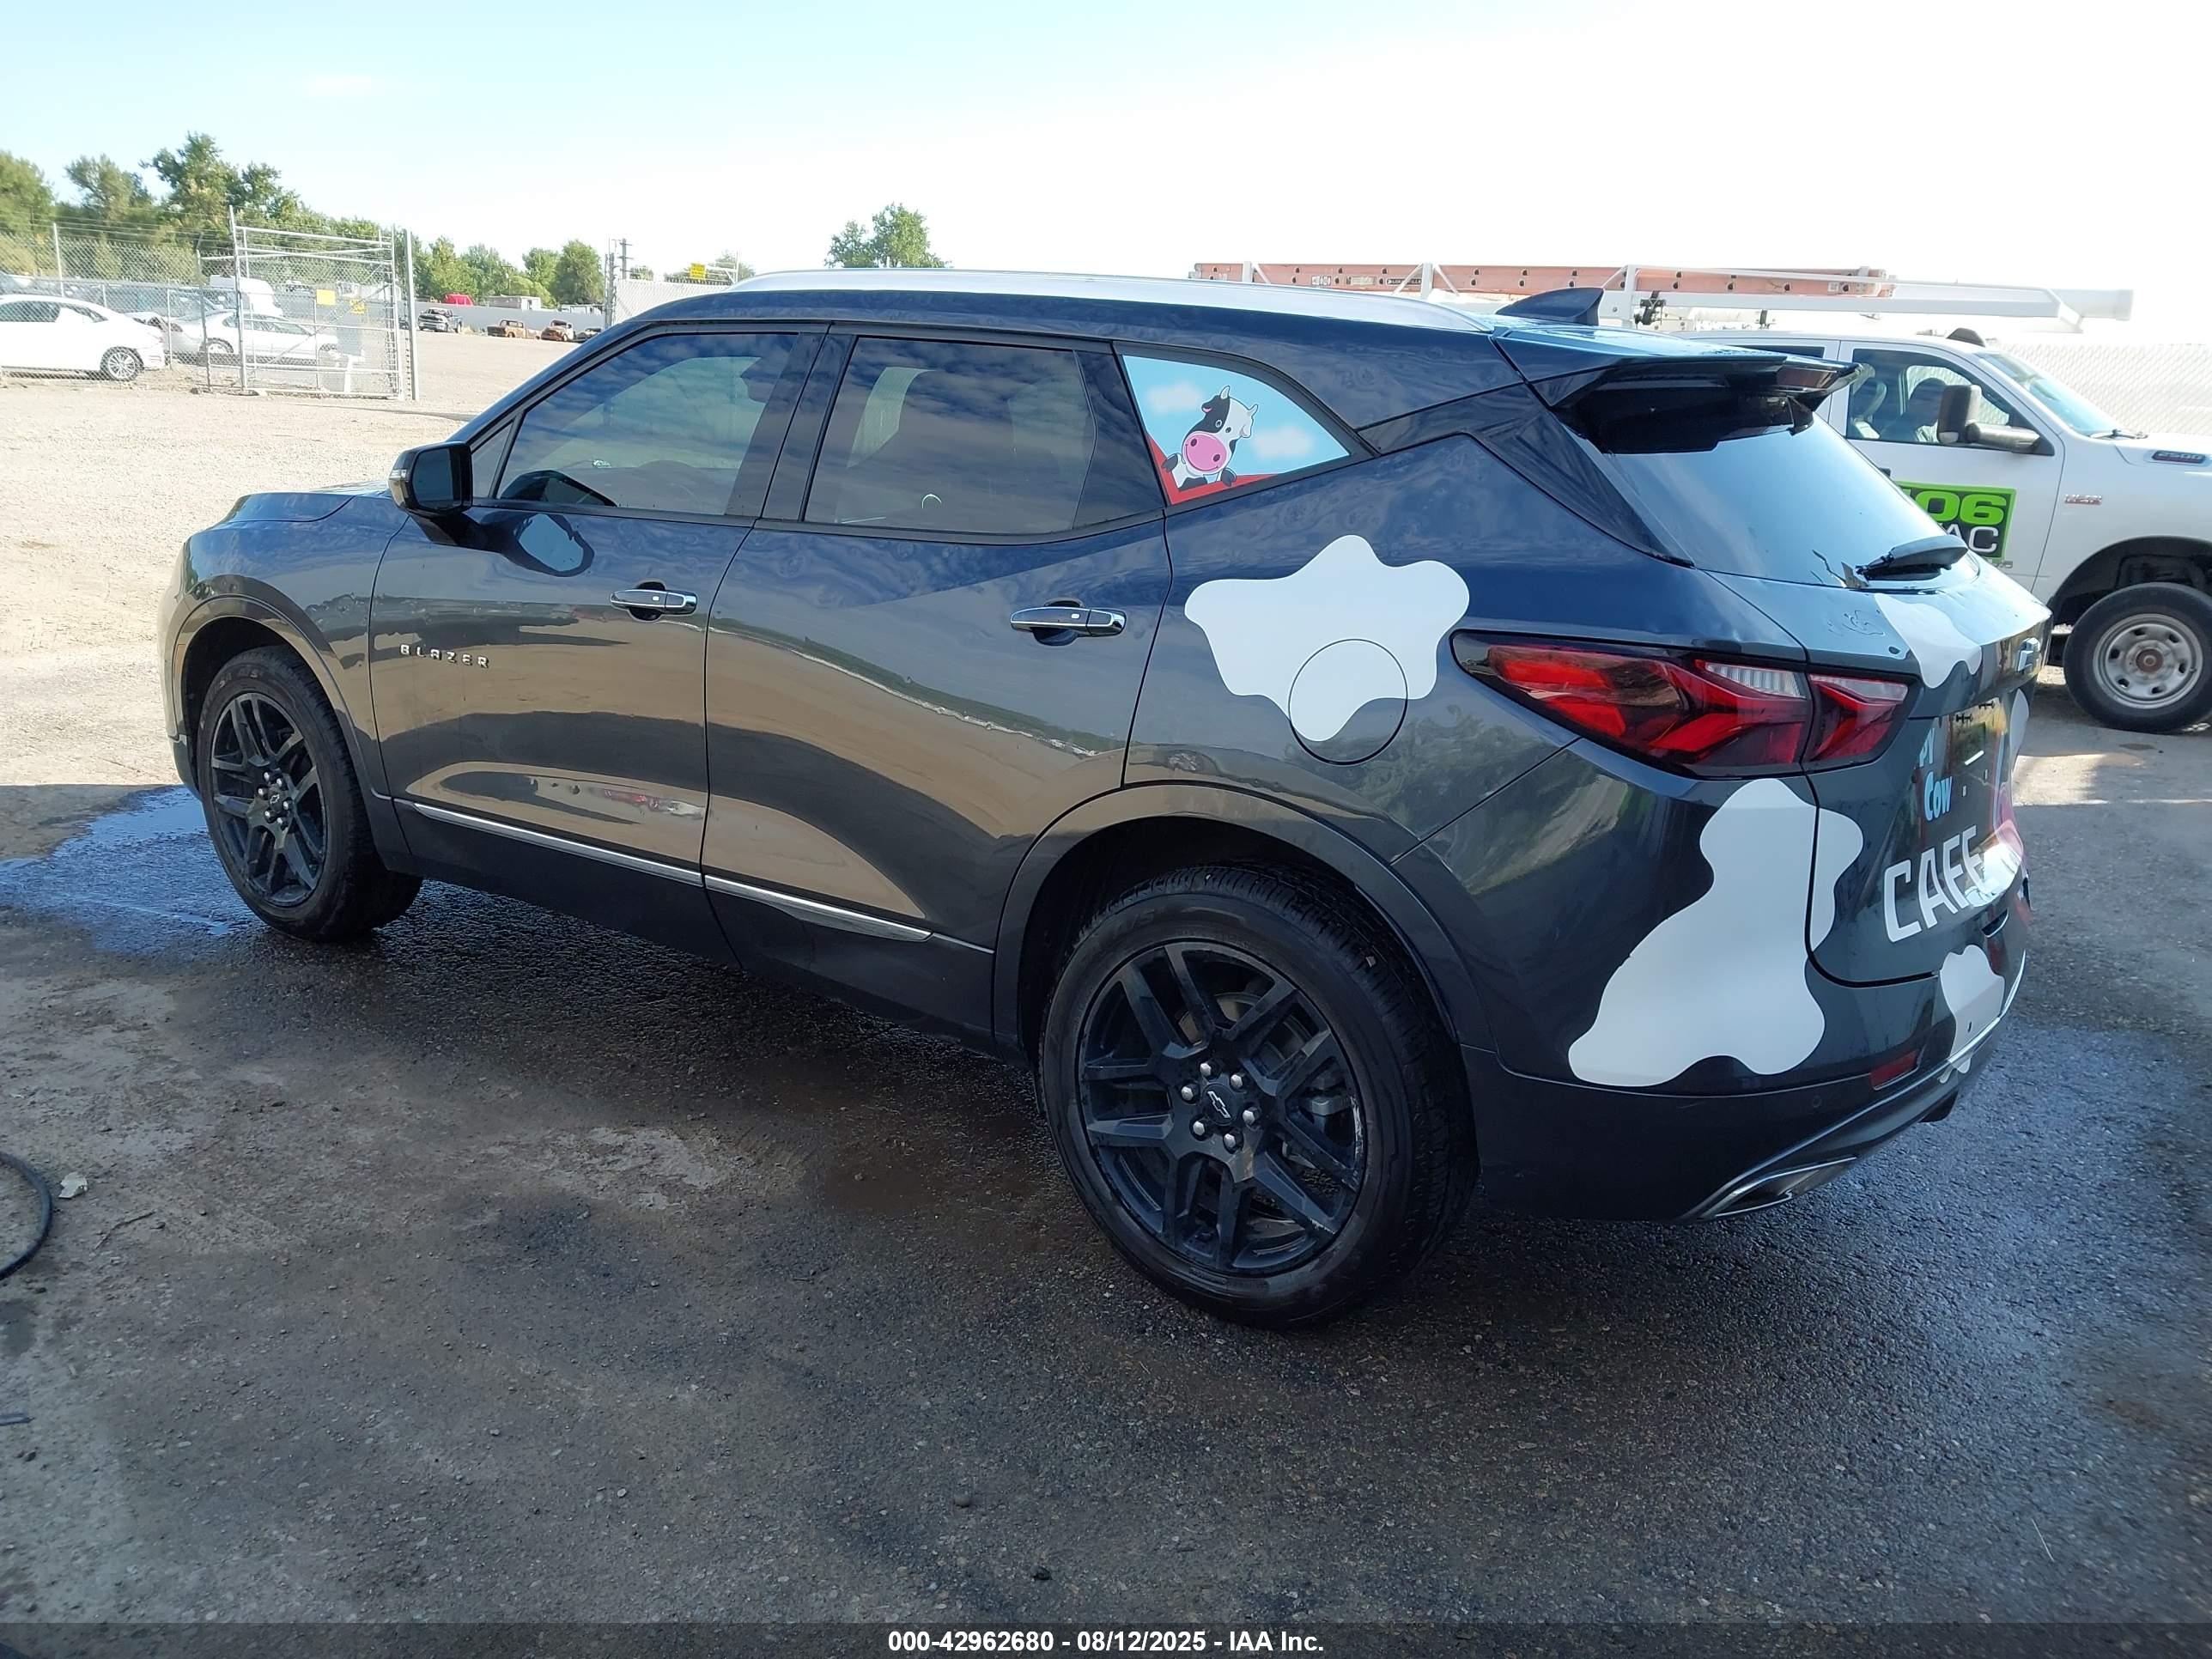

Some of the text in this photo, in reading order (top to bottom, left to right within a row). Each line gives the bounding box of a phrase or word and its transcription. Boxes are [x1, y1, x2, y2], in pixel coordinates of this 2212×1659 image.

[1902, 489, 2007, 526] 06
[400, 644, 489, 669] BLAZER
[1884, 824, 1990, 943] CAFE
